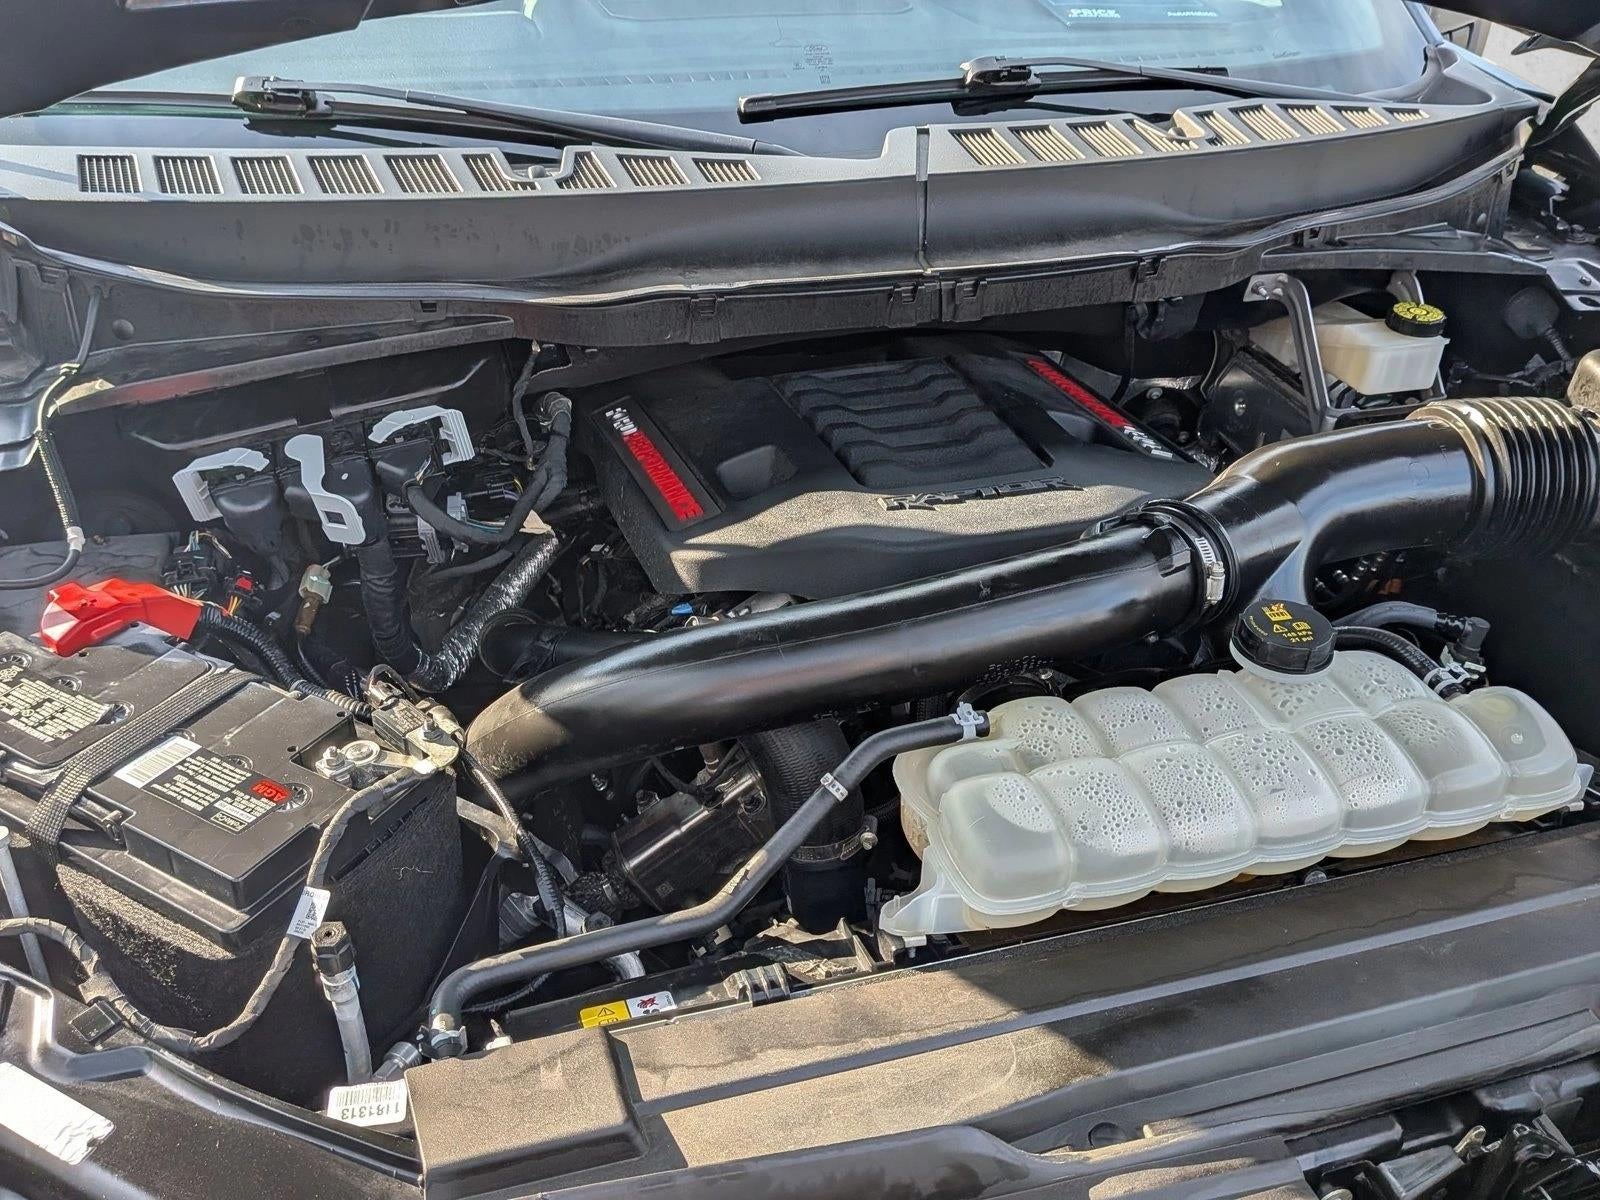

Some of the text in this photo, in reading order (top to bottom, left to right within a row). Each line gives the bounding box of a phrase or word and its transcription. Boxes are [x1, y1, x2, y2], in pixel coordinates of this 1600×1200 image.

[877, 476, 1085, 511] RAPTOR
[251, 783, 286, 801] AGM
[214, 811, 247, 830] FoMoCo
